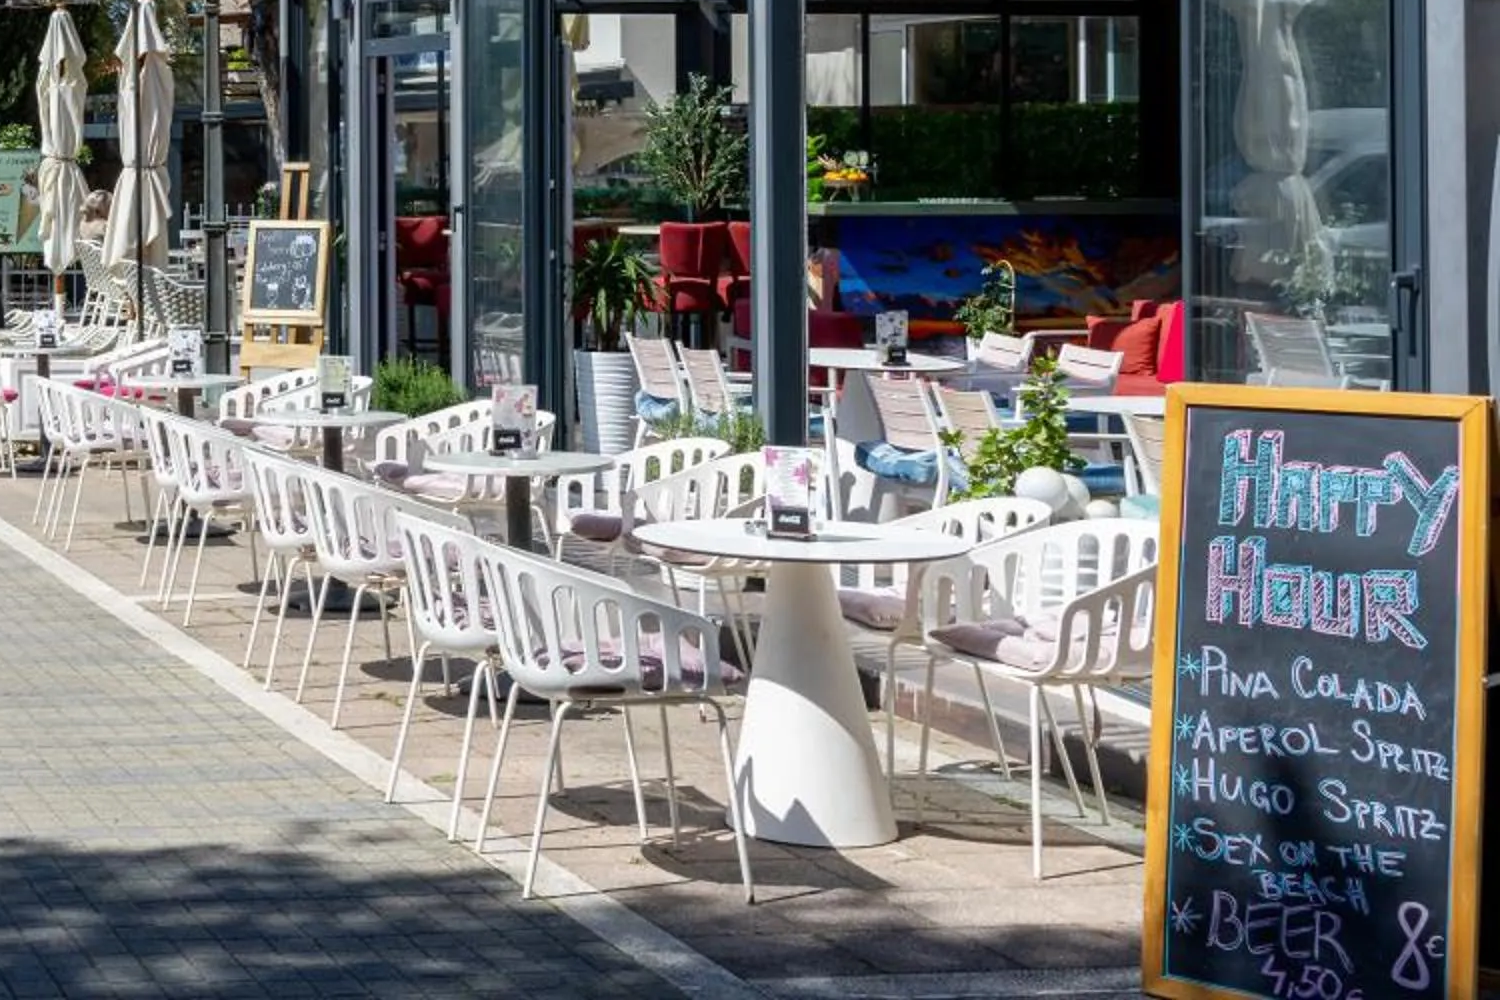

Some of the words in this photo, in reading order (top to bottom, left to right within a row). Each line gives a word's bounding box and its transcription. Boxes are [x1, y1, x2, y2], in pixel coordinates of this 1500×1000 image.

[1218, 429, 1461, 557] HAPPY
[1205, 535, 1428, 649] HOUR
[1201, 645, 1280, 699] PINA
[1291, 655, 1427, 721] COLADA
[1192, 710, 1339, 757] APEROL
[1351, 719, 1451, 781] SPRITZ
[1192, 757, 1296, 814] HUGO
[1318, 778, 1447, 841] SPRITZ
[1192, 817, 1272, 866] SEX
[1279, 840, 1317, 867] ON
[1325, 842, 1406, 877] THE
[1206, 890, 1356, 974] BEER
[1253, 869, 1370, 916] BEACH
